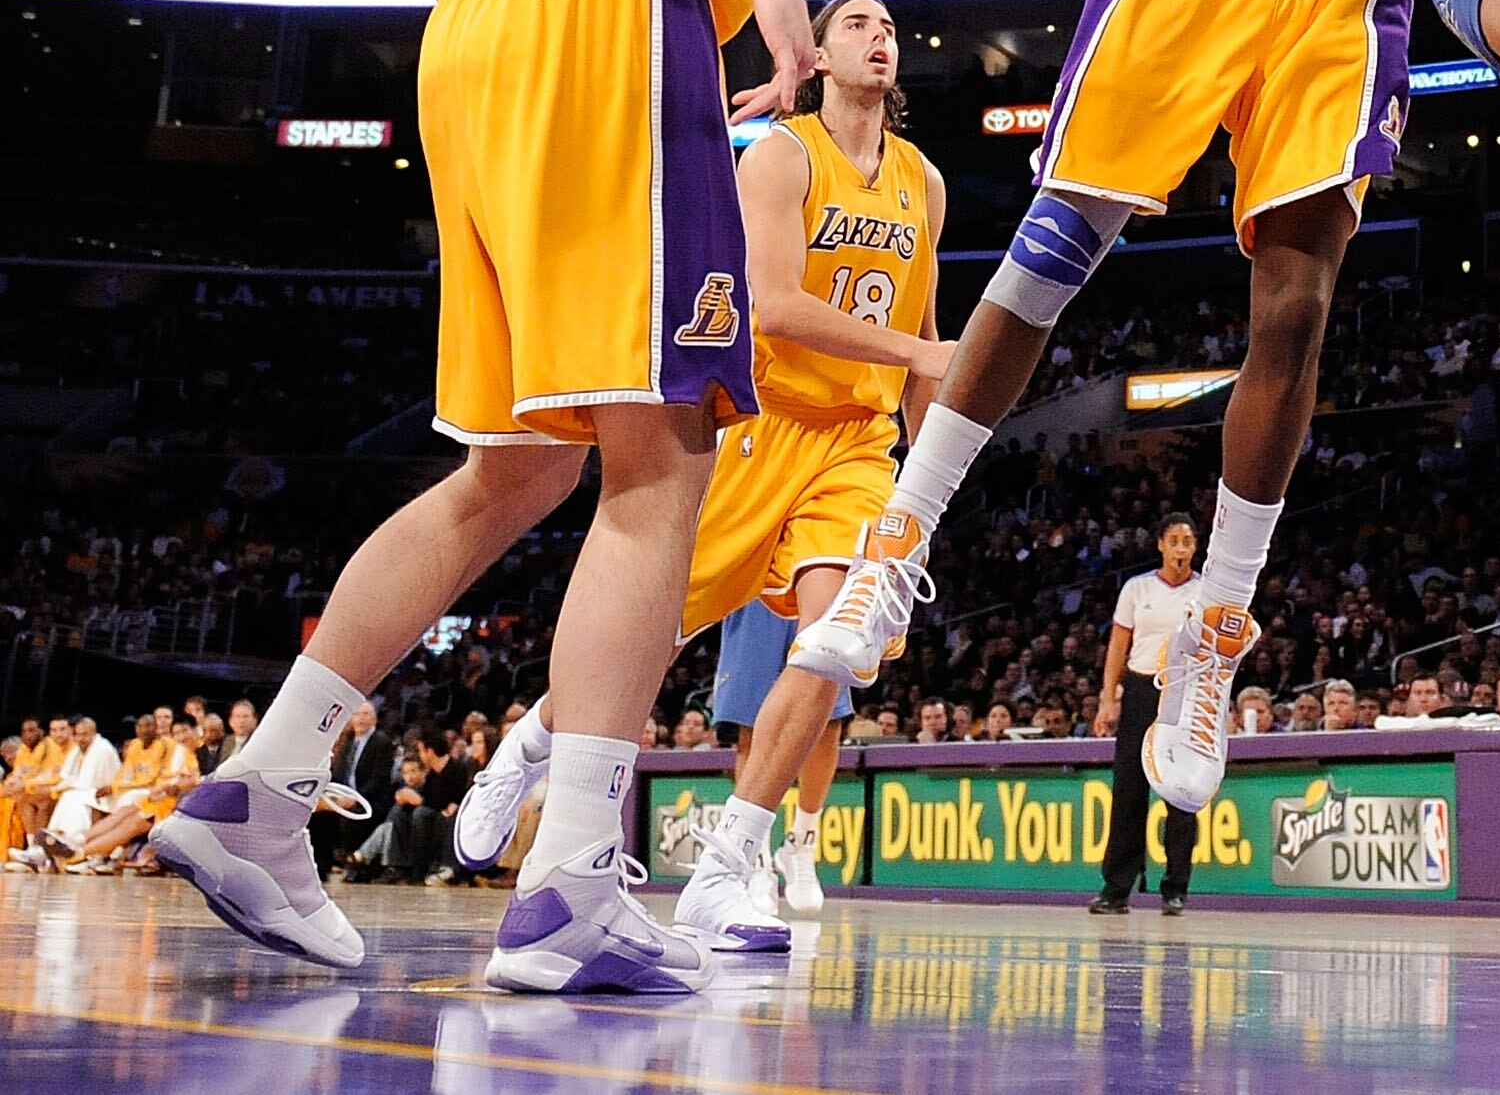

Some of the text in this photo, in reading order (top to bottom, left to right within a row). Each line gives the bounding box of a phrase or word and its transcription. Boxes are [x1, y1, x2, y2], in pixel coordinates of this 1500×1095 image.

[1408, 67, 1497, 89] WACHOVIA
[287, 120, 384, 147] STAPLES
[807, 205, 917, 260] LAKERS
[828, 265, 896, 328] 18
[780, 779, 1253, 885] Tey Dunk. You Dce.
[1280, 797, 1420, 856] Sprite SLAM
[1331, 841, 1419, 882] DUNK
